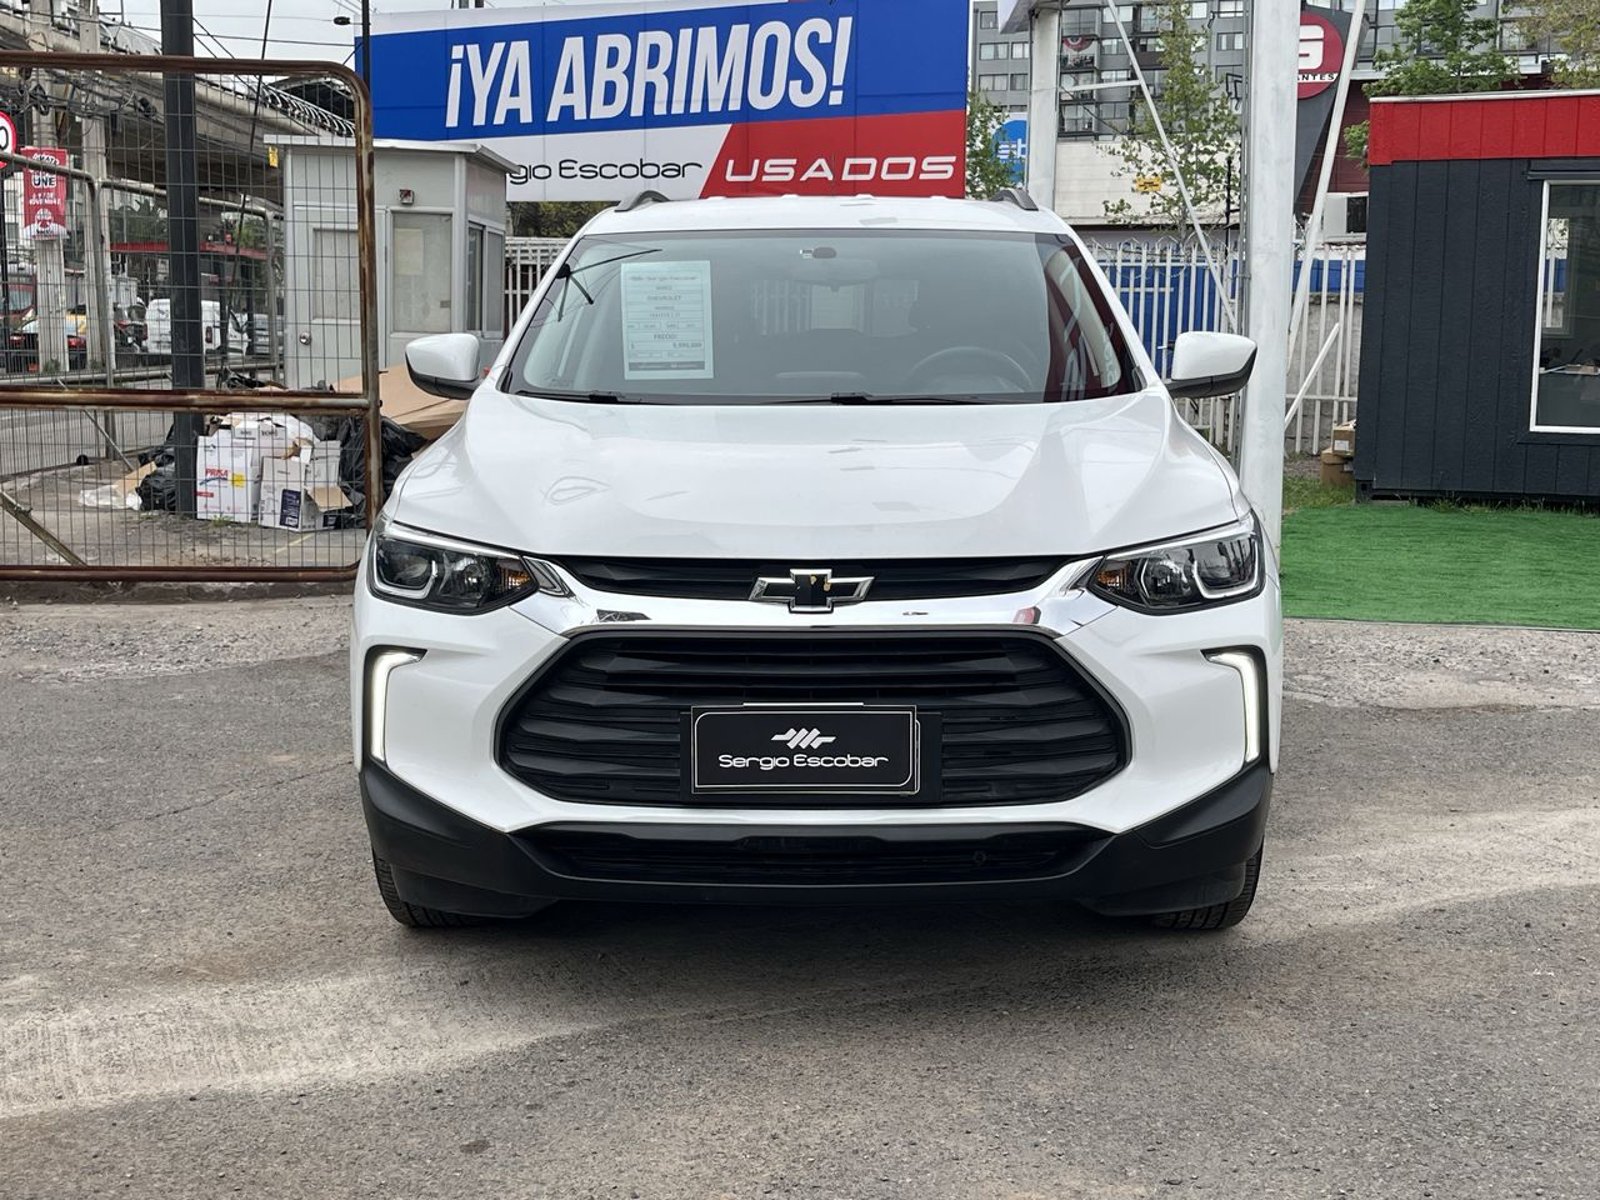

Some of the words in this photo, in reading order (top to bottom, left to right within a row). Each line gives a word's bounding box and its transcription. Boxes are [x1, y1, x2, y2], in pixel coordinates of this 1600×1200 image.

[445, 40, 531, 128] ¡YA
[547, 16, 853, 122] ABRIMOS!
[559, 158, 702, 180] Escobar
[725, 155, 957, 182] USADOS
[33, 175, 56, 187] UNE
[718, 754, 790, 770] Sergio
[793, 753, 889, 768] Escobar
